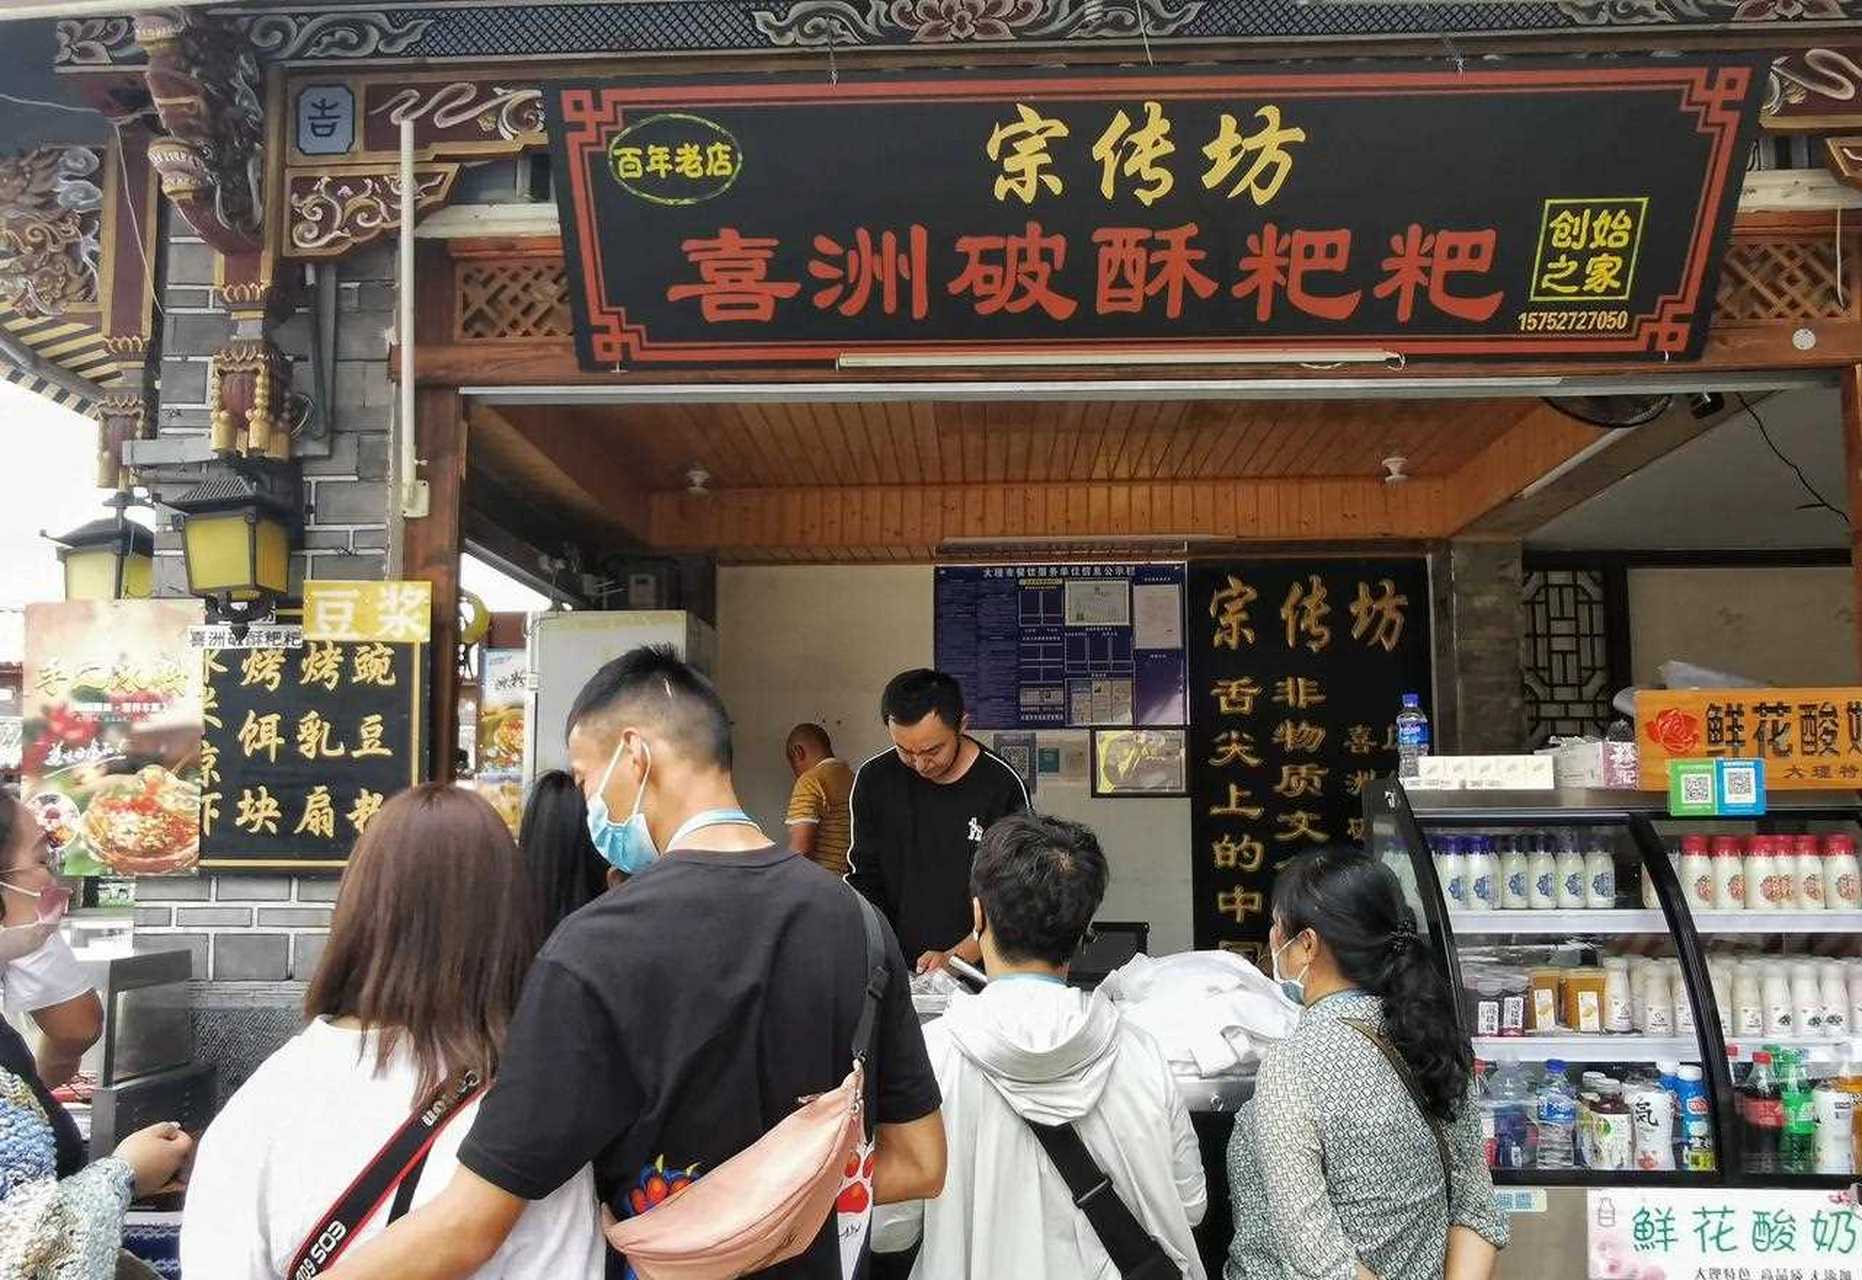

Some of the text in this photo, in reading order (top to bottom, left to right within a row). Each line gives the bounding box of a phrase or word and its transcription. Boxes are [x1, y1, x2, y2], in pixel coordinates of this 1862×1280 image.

[613, 142, 737, 180] 百年老店
[985, 103, 1307, 205] 宗传坊
[1548, 208, 1633, 251] 创始
[667, 221, 1504, 324] 喜洲破酥粑粑
[1540, 254, 1624, 295] 之家
[1518, 310, 1629, 332] 15752727050
[312, 586, 429, 640] 豆浆
[1209, 575, 1409, 652] 宗传坊
[238, 648, 287, 835] 烤饵块
[294, 641, 345, 839] 烤乳扇
[1271, 676, 1330, 872] 非物质文
[310, 1219, 347, 1265] EOS
